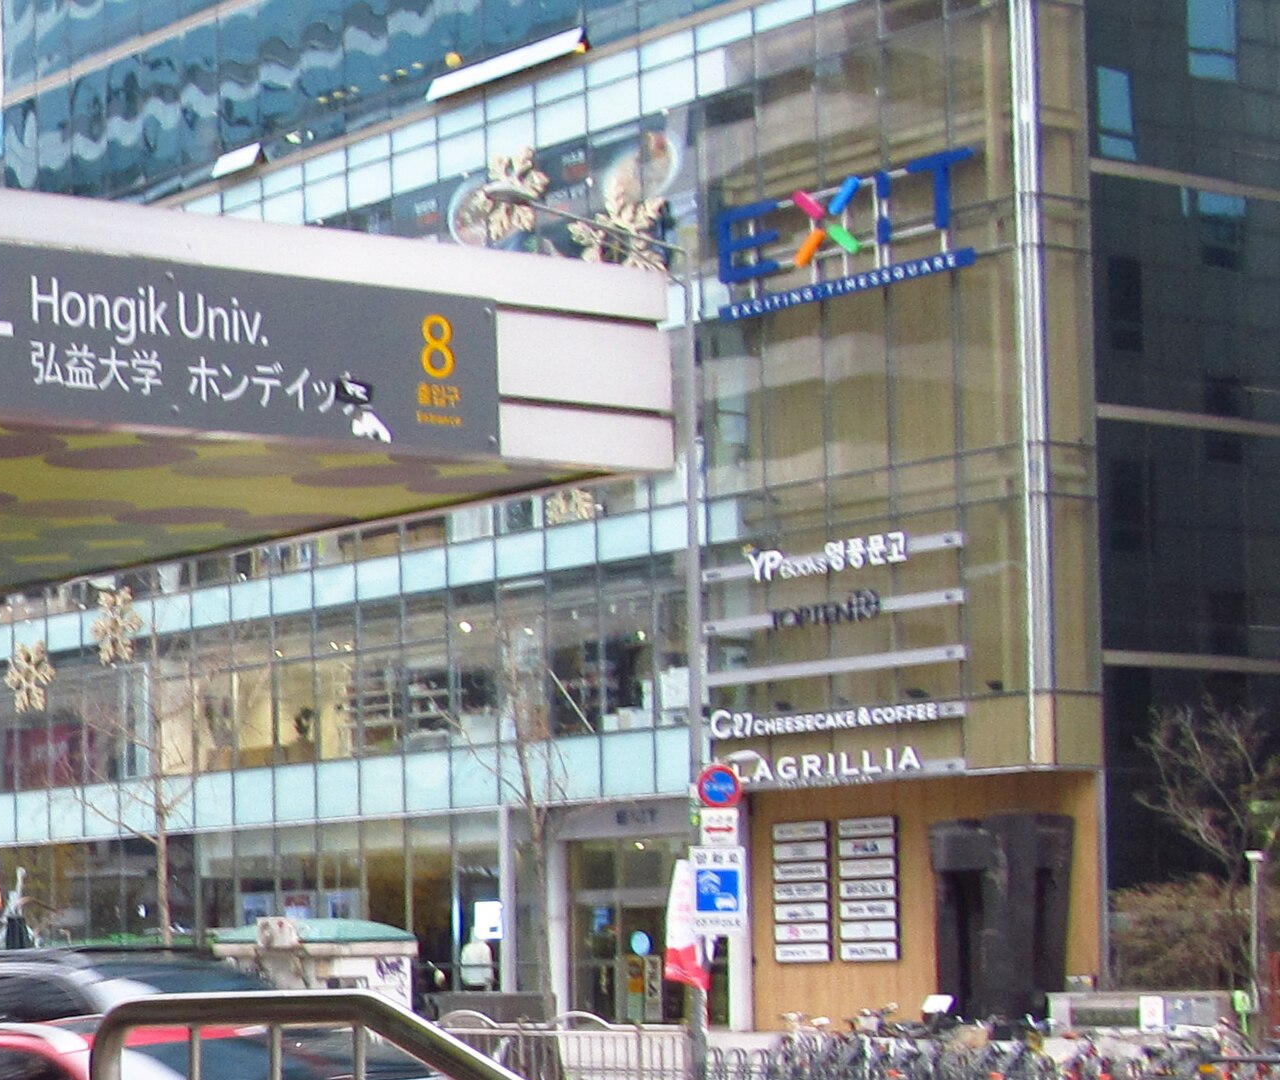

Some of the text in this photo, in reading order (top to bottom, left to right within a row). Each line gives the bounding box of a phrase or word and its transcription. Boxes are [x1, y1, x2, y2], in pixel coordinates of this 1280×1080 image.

[717, 146, 975, 284] EXIT
[30, 274, 270, 348] Hongik Univ.
[420, 313, 457, 379] 8
[30, 340, 164, 397] 弘益大学
